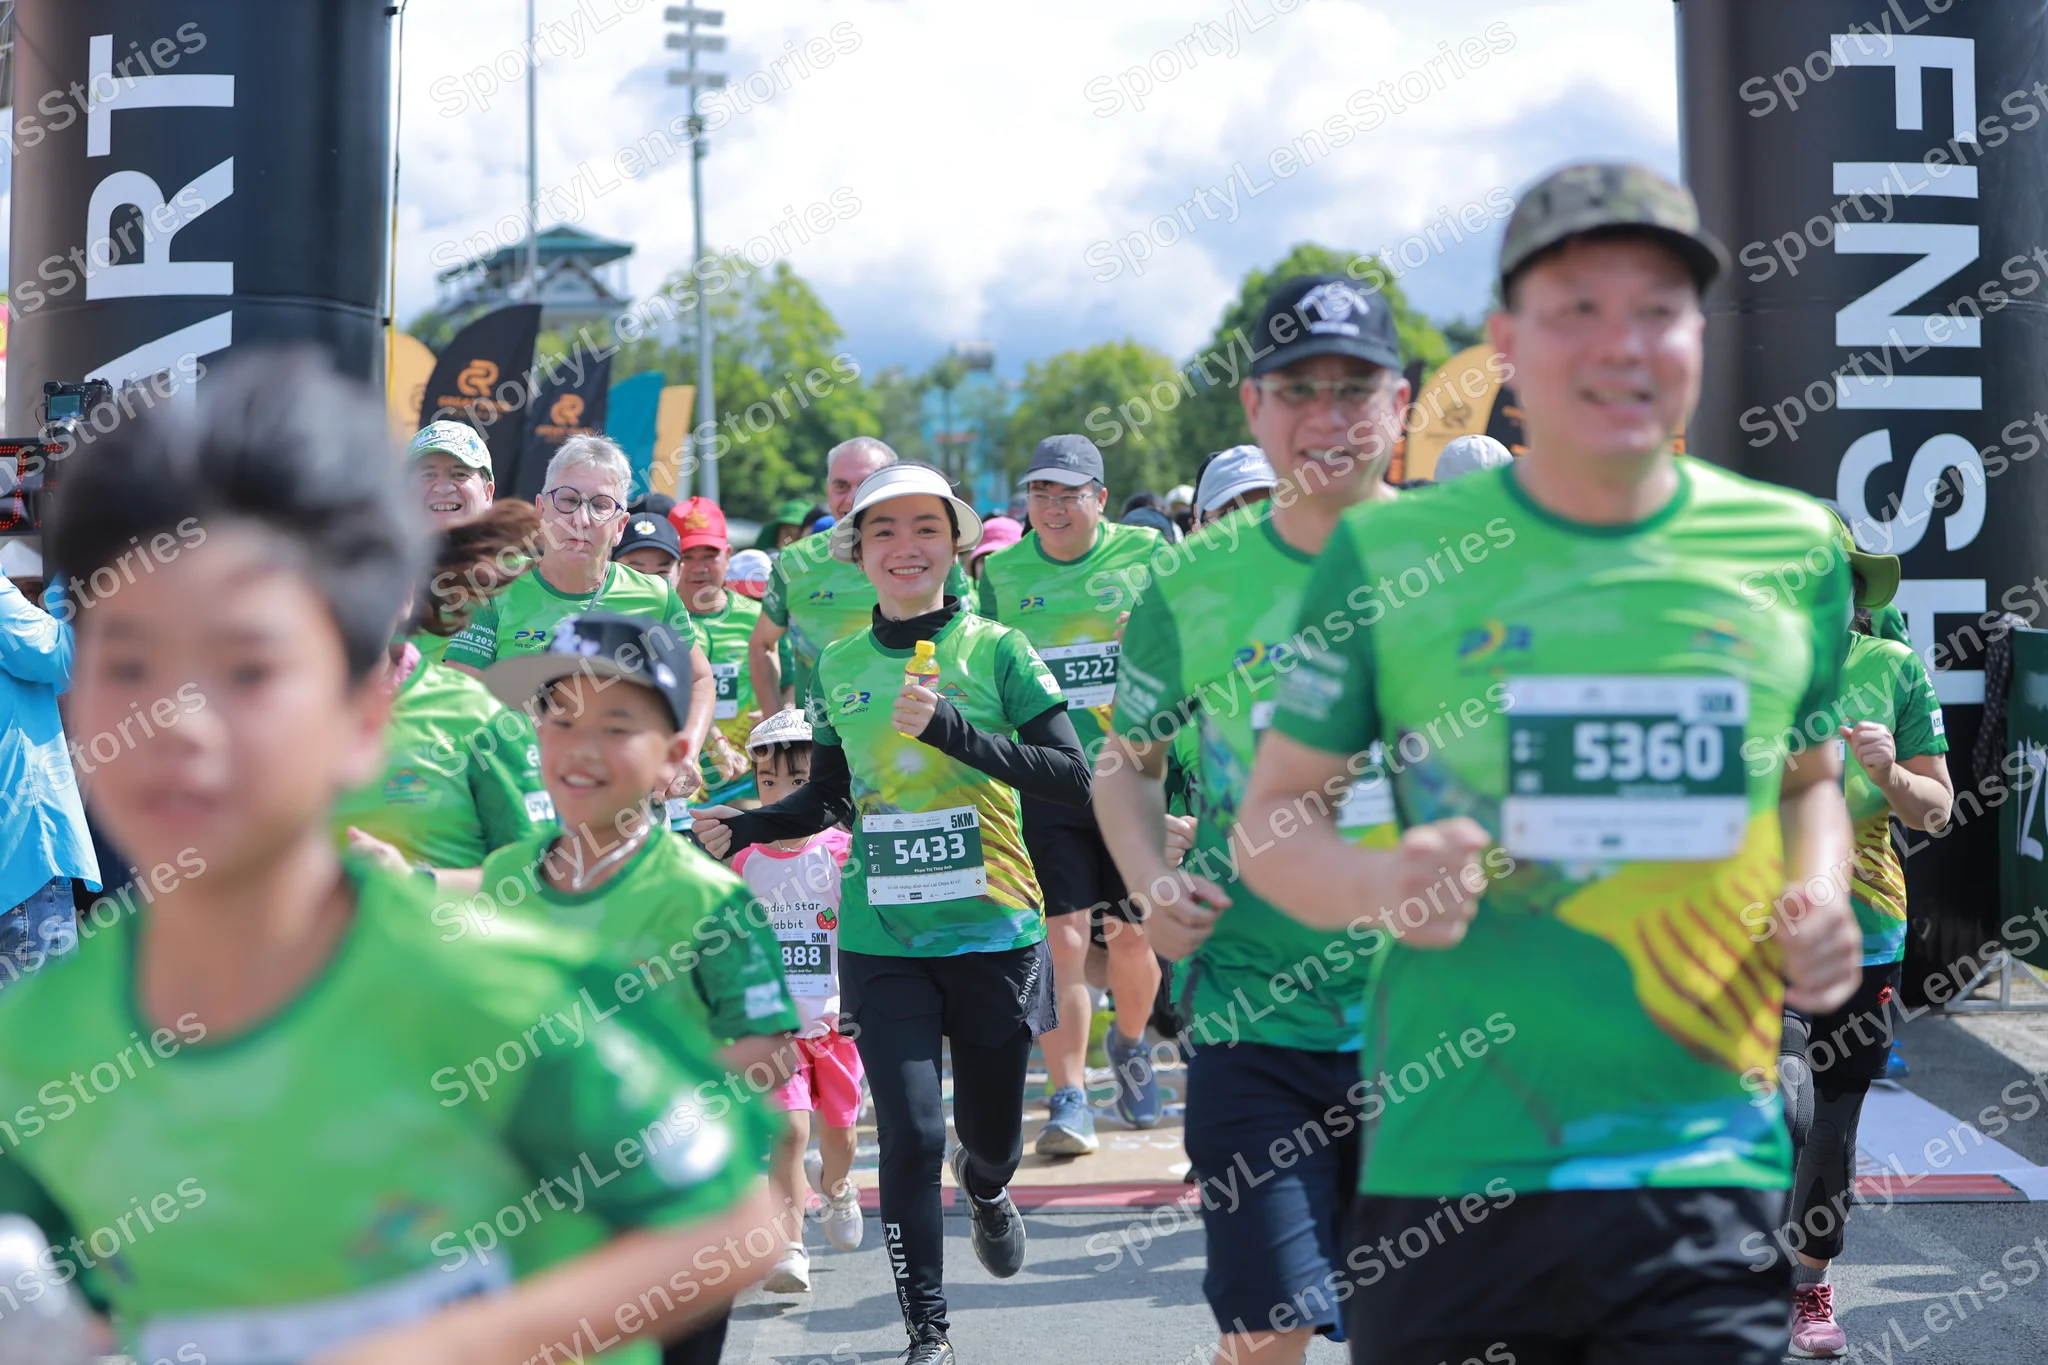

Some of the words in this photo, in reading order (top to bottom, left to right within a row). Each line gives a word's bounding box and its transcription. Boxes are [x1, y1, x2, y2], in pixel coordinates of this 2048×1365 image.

[1830, 34, 1988, 706] FINISH
[1064, 658, 1115, 682] 5222
[1572, 721, 1724, 781] 5360
[951, 812, 974, 829] 5KM
[894, 833, 966, 865] 5433
[795, 902, 820, 911] star
[811, 933, 828, 943] 5KM
[885, 1223, 910, 1279] RUN
